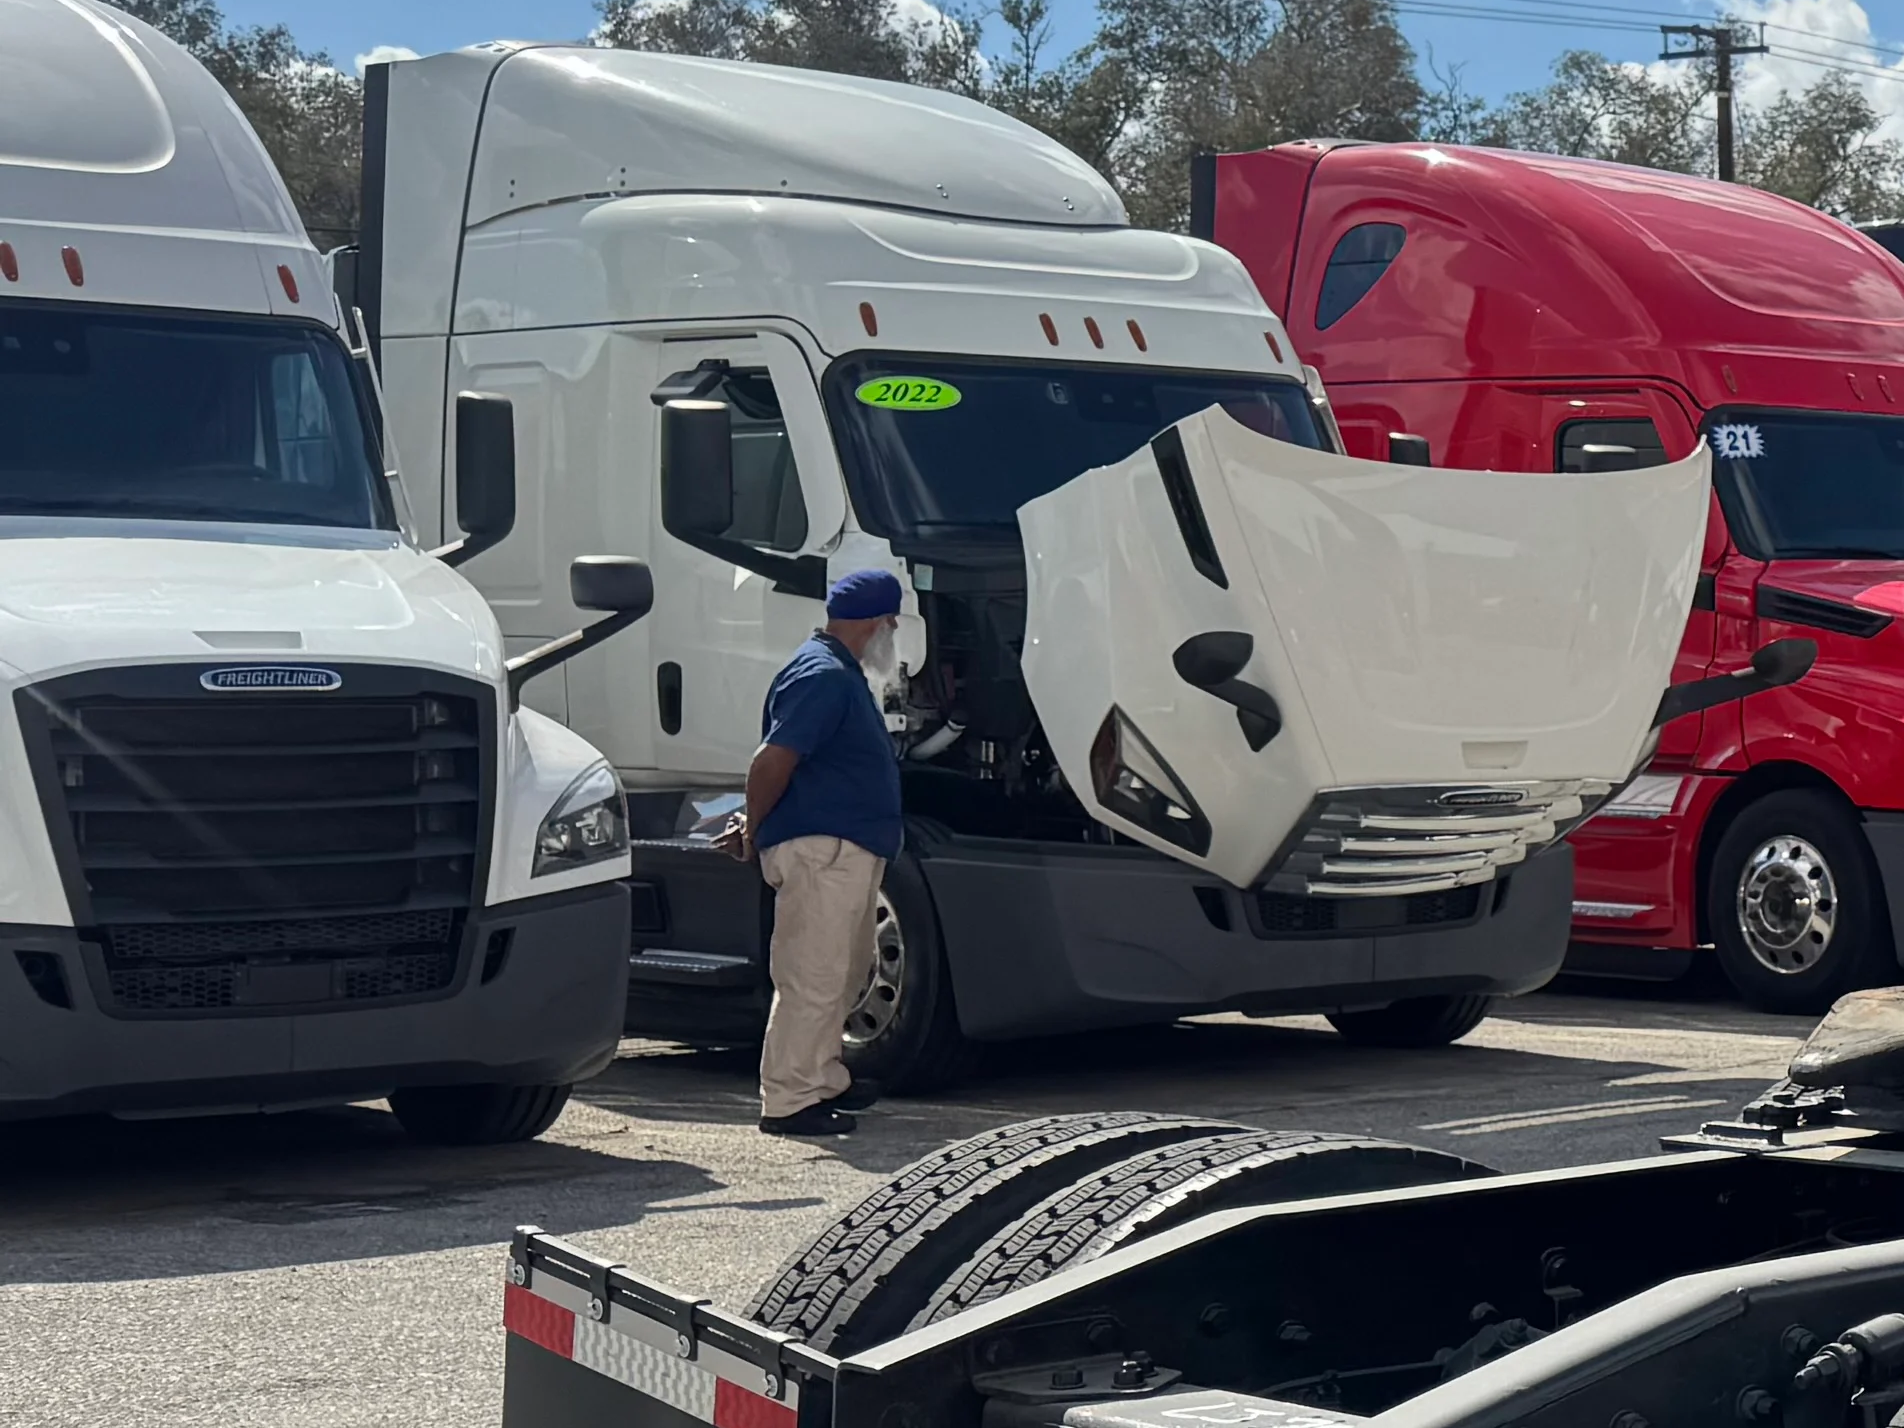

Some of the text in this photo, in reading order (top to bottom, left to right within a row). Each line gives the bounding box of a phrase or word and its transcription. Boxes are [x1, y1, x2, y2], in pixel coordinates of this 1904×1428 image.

[874, 383, 942, 403] 2022
[1726, 430, 1751, 451] 21
[217, 671, 328, 686] FREIGHTLINER
